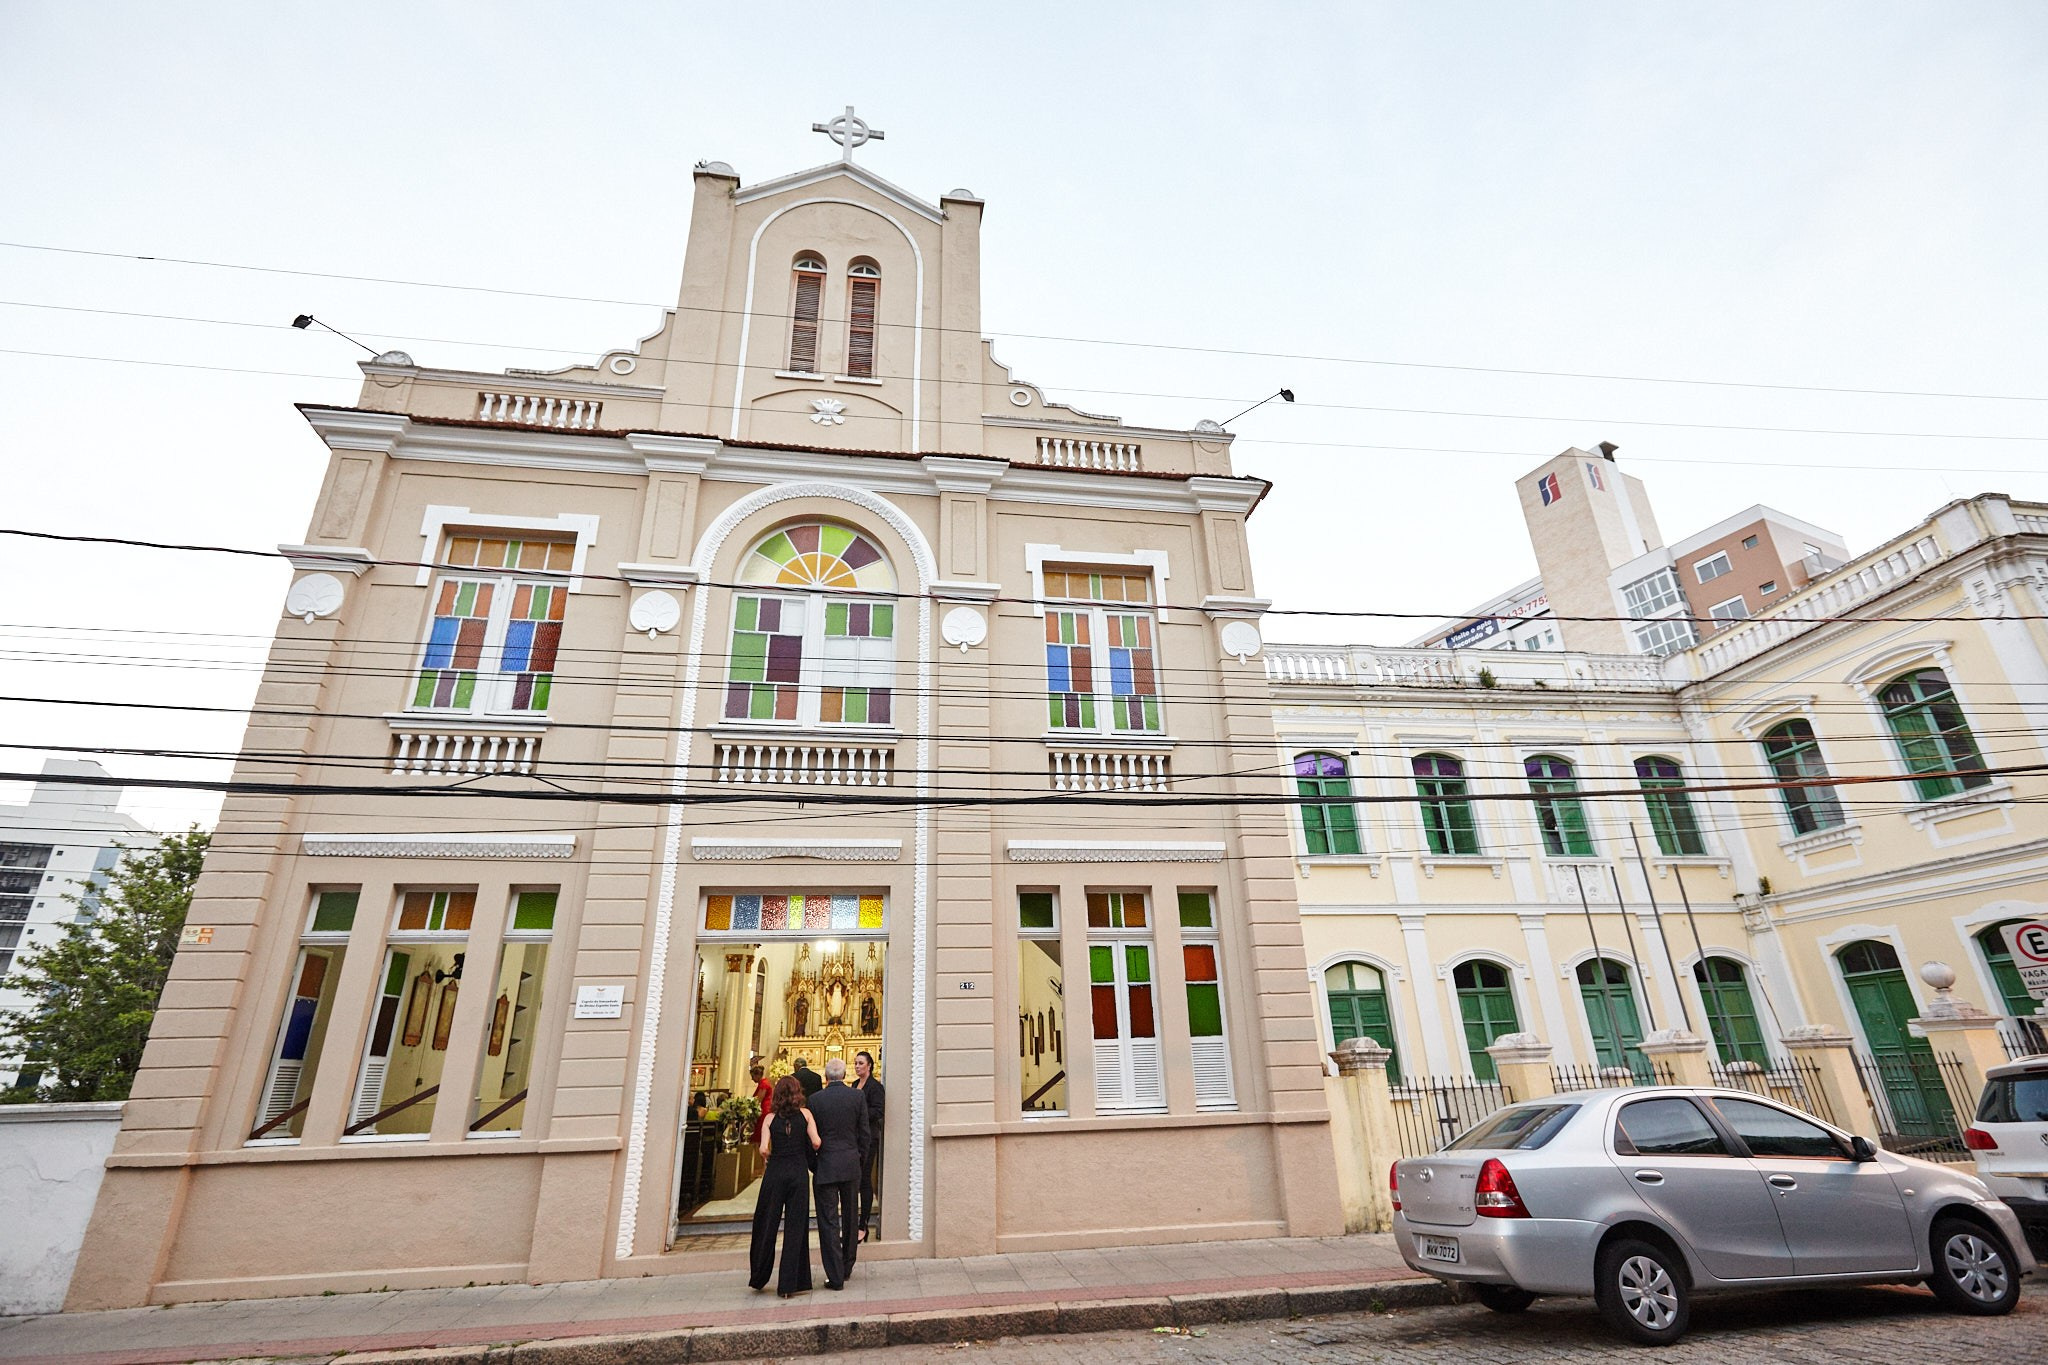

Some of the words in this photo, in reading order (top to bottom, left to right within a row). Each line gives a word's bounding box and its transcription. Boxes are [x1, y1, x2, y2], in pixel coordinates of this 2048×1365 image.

[1450, 630, 1470, 643] Visite
[1476, 619, 1492, 631] apto
[2027, 932, 2048, 954] E
[2021, 969, 2047, 978] VAGA
